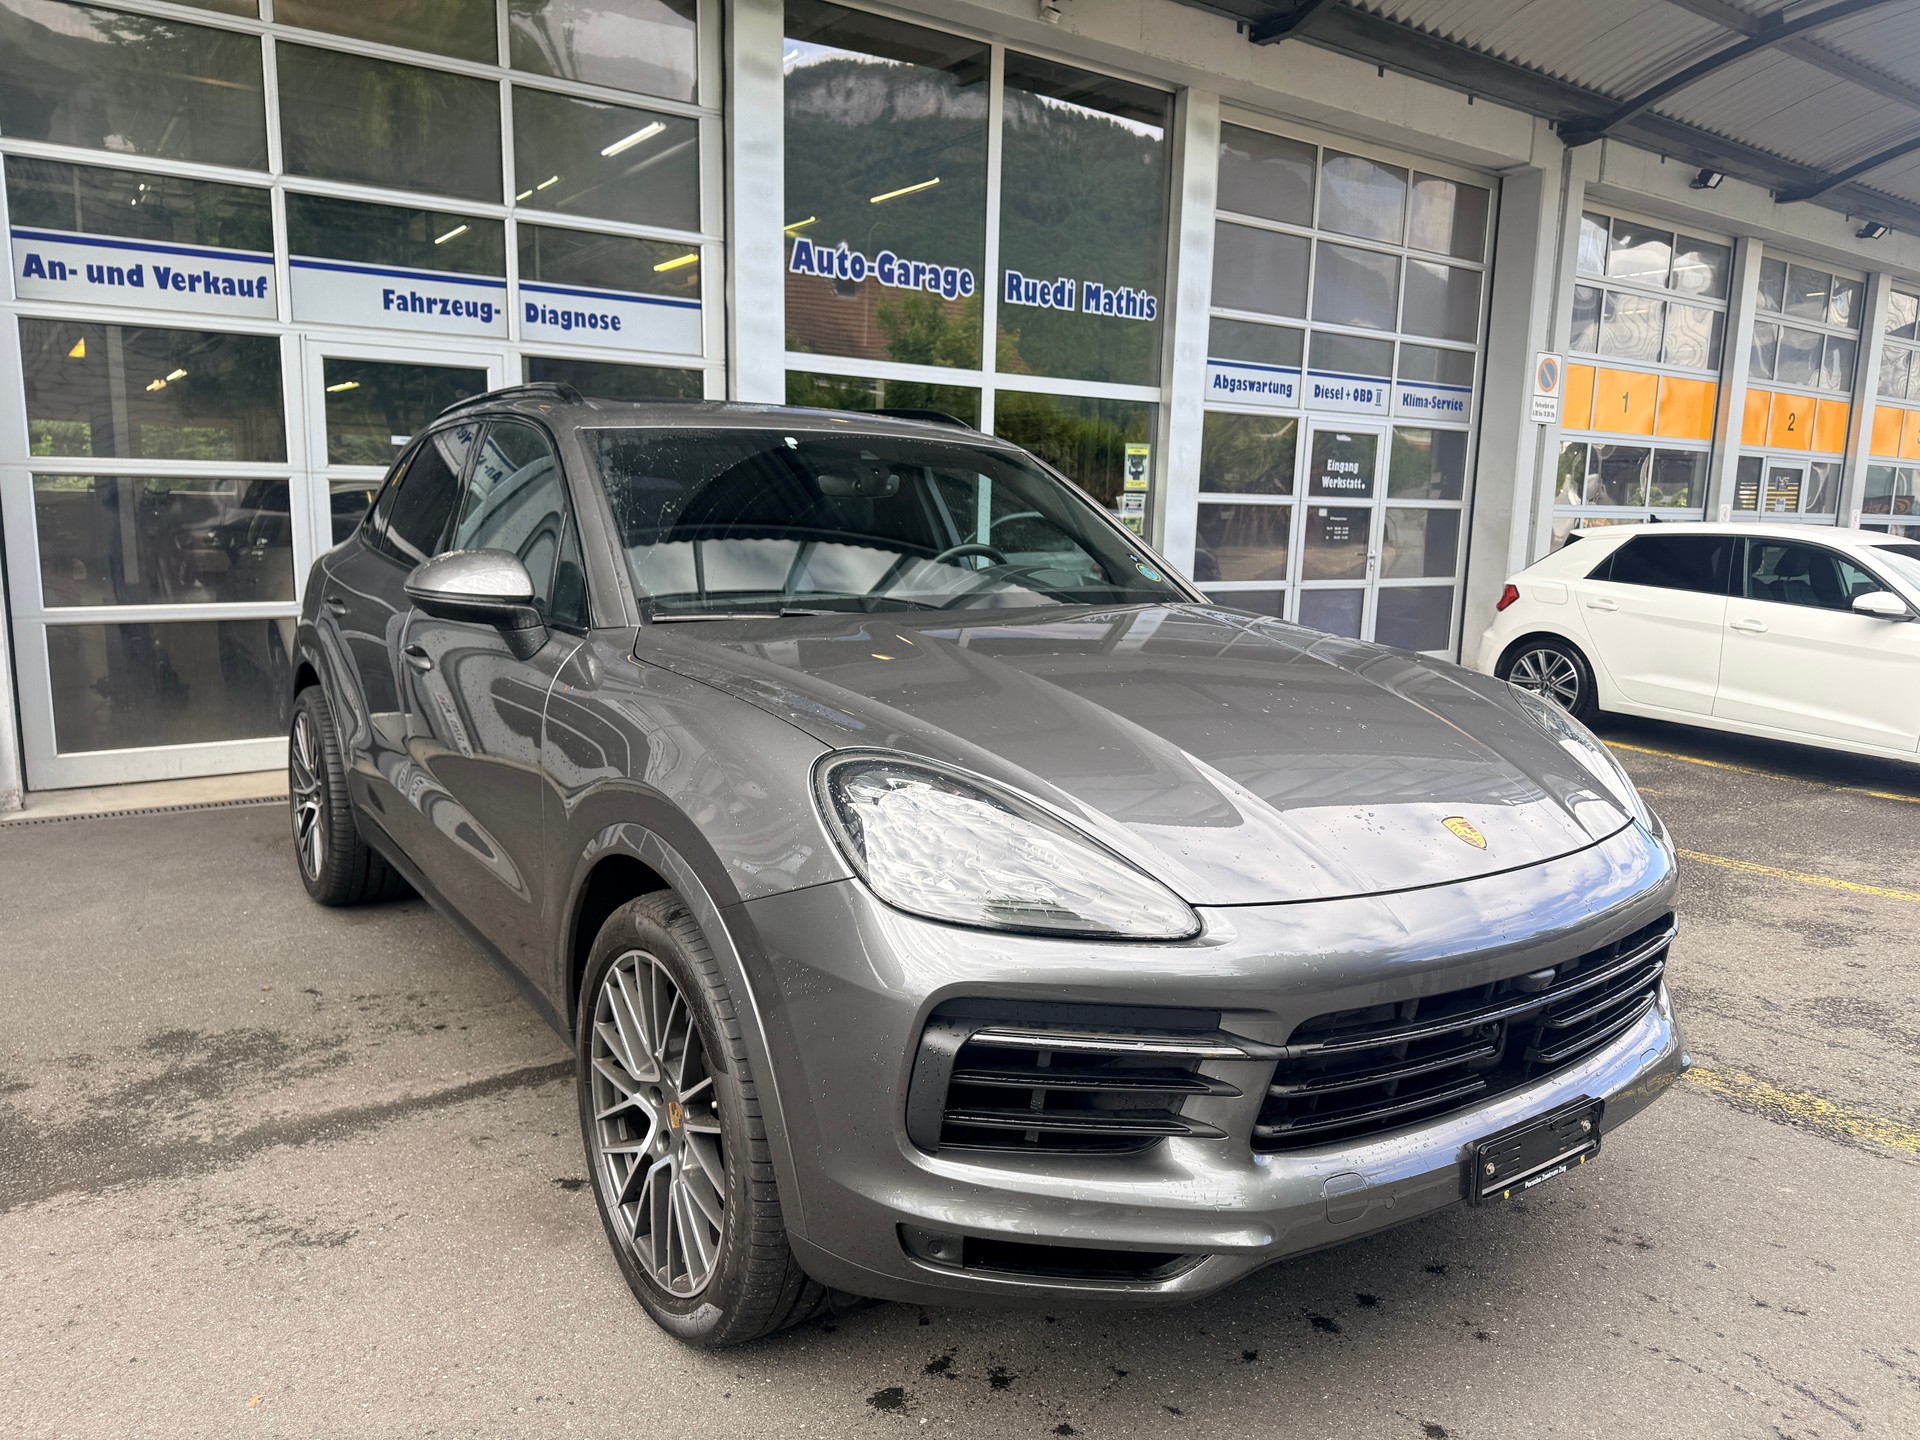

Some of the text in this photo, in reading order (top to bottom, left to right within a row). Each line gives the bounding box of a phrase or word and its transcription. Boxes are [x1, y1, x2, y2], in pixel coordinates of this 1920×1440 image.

[22, 253, 268, 299] An- und Verkauf
[791, 238, 1157, 321] Auto-Garage Ruedi Mathis
[382, 288, 621, 331] Fahrzeug- Diagnose
[1213, 374, 1293, 398] Abgaswartung
[1314, 384, 1343, 401] Diesel
[1346, 389, 1351, 400] +
[1353, 388, 1373, 403] OBD
[1402, 393, 1463, 412] Klima-Service
[1621, 392, 1629, 413] 1
[1787, 413, 1796, 431] 2
[1327, 459, 1359, 475] Eingang
[1524, 1176, 1541, 1189] Porsche
[1541, 1169, 1559, 1181] Zentrum
